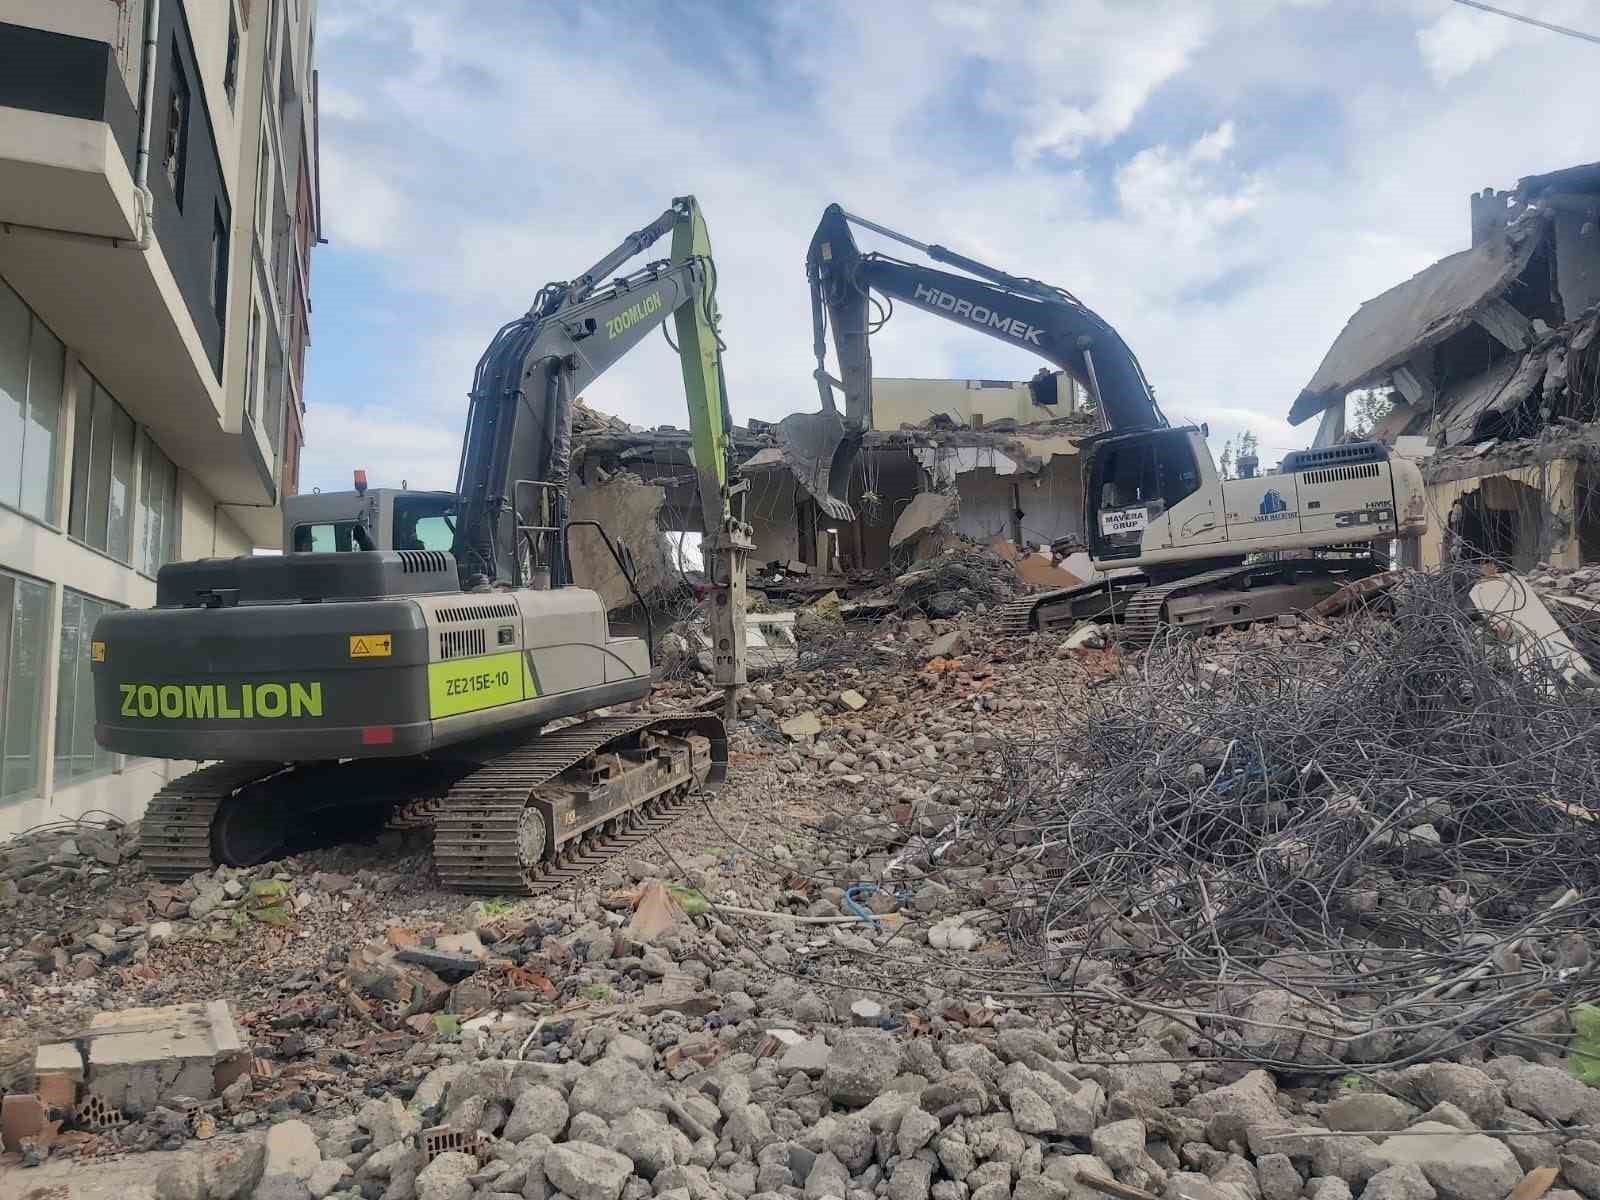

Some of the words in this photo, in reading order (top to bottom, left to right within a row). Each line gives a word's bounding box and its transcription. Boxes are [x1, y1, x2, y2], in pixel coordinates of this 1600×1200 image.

[606, 291, 661, 339] ZOOMLION
[1113, 520, 1138, 529] GRUP
[446, 671, 509, 696] ZE215E-10
[119, 682, 323, 719] ZOOMLION
